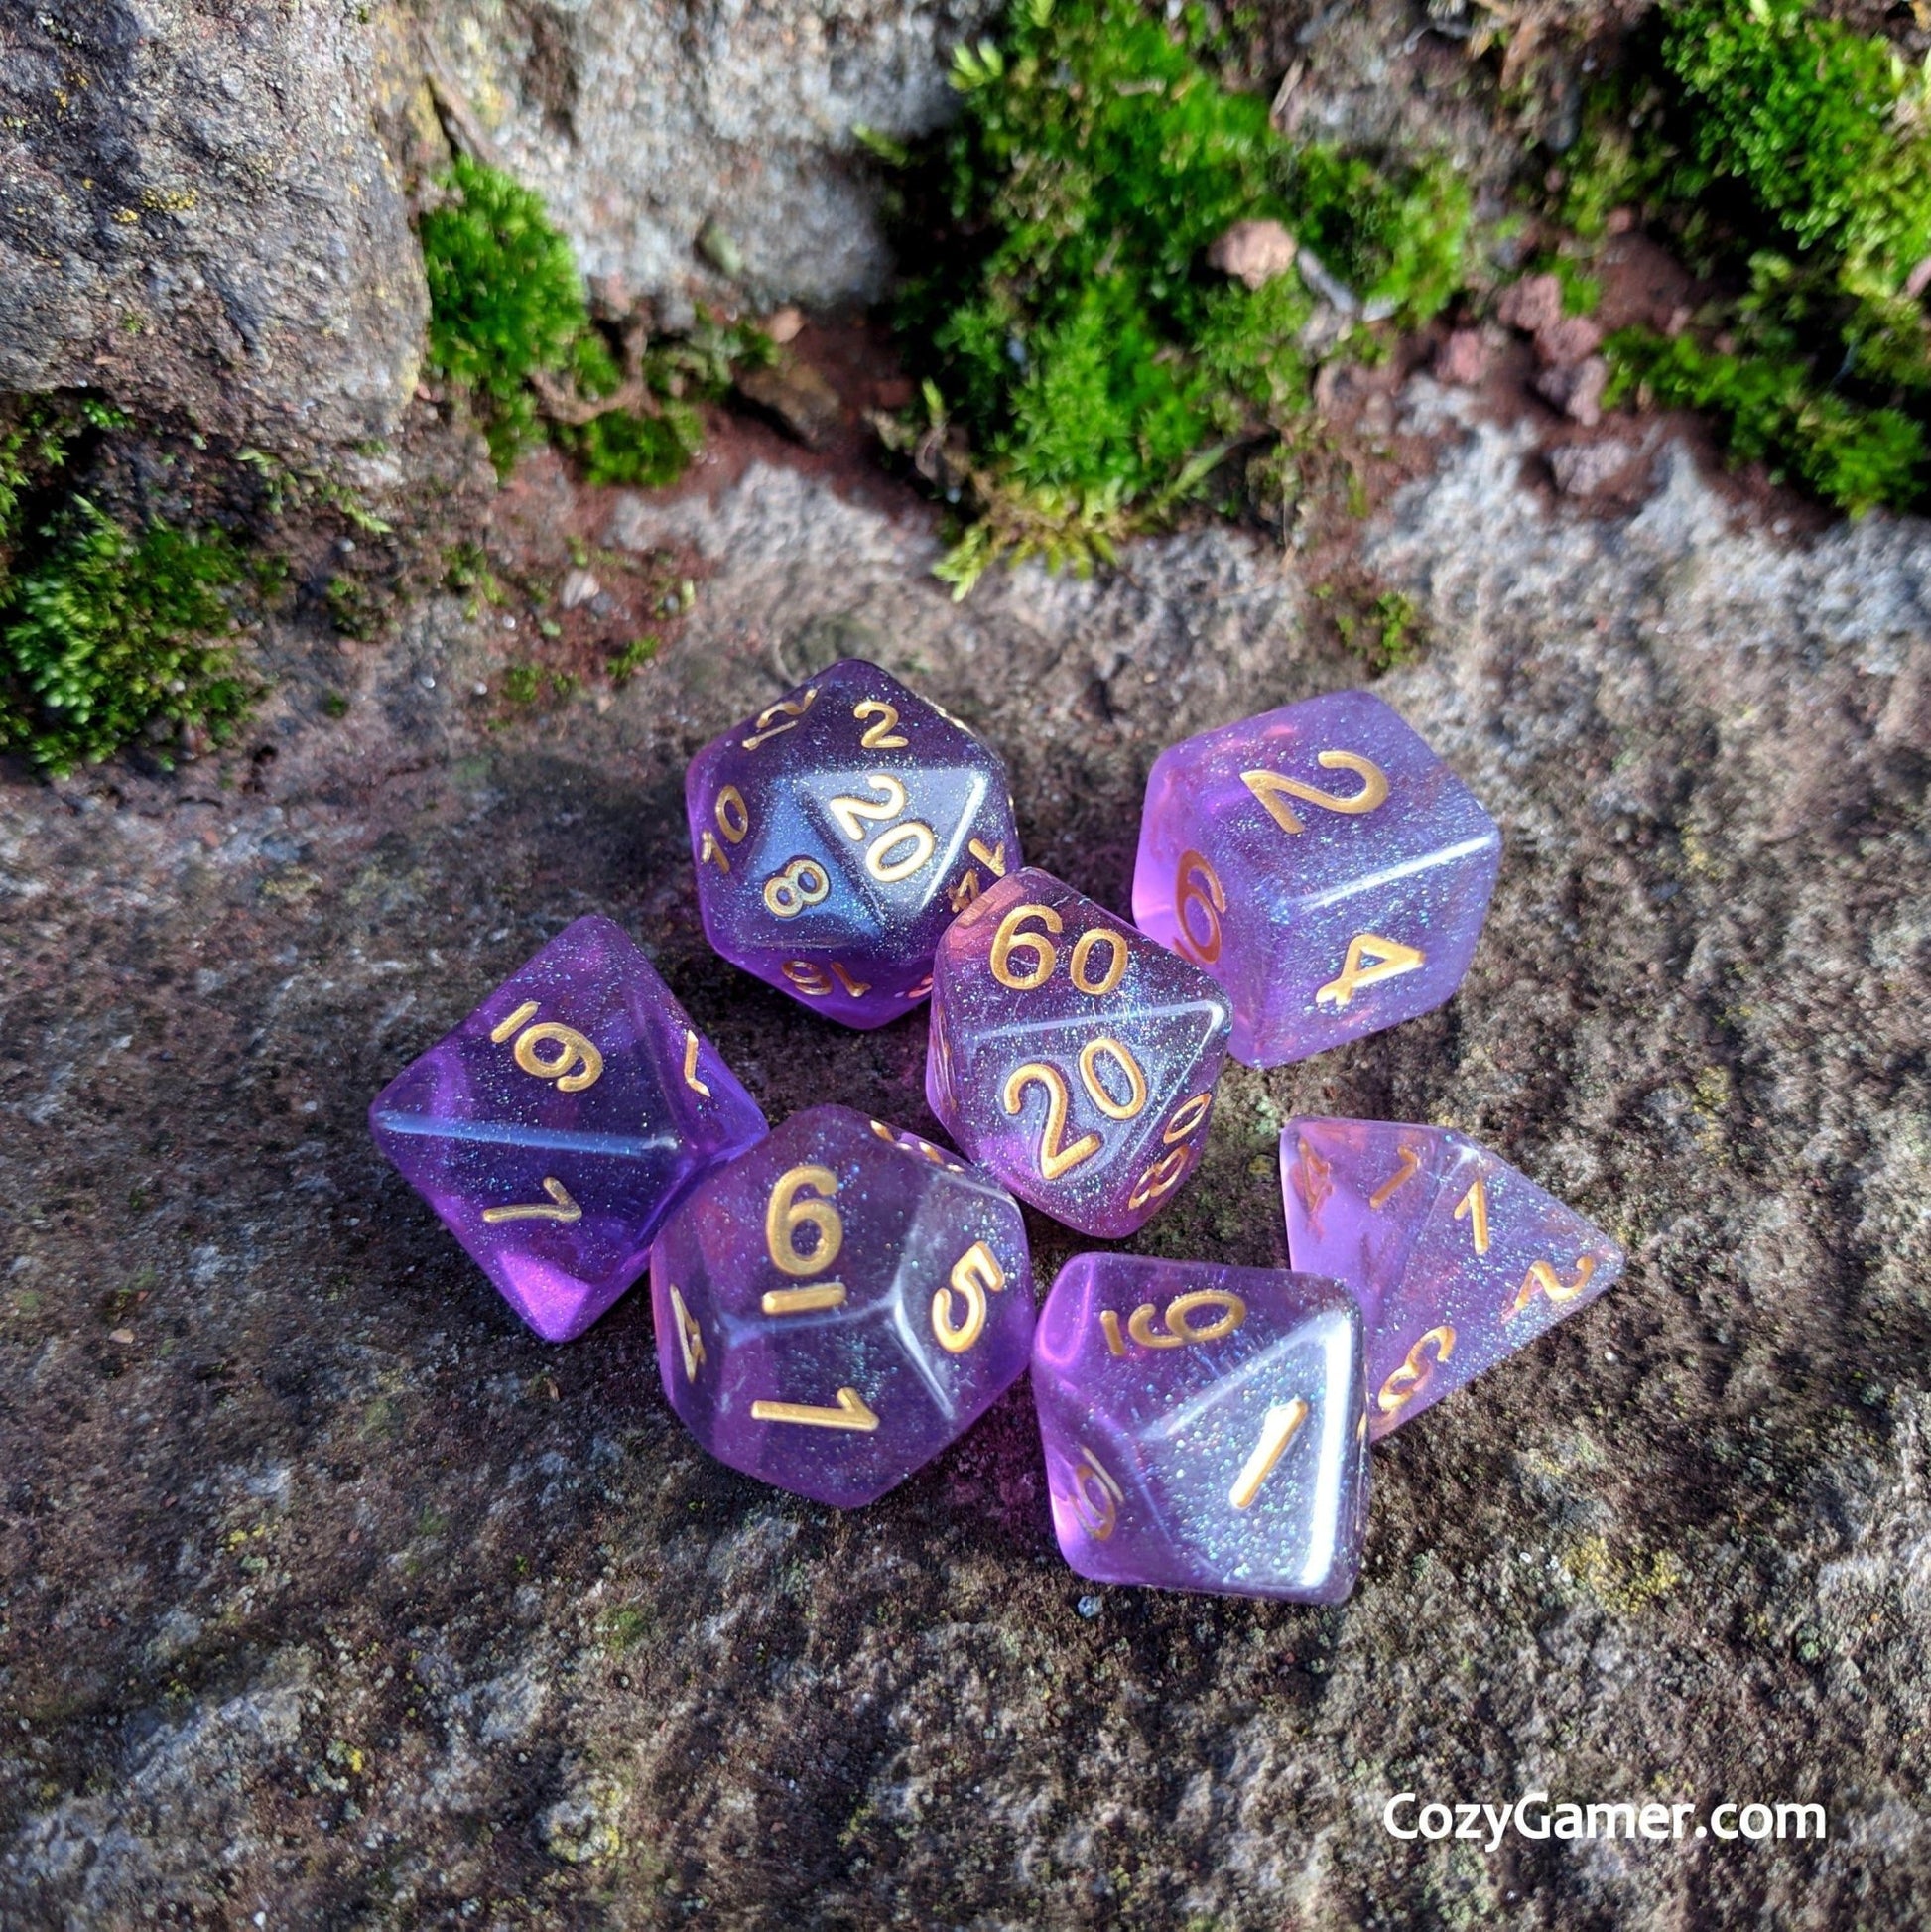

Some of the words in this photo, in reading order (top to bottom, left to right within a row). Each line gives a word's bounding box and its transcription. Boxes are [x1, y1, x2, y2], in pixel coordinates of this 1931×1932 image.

[852, 699, 910, 750] 2
[700, 784, 749, 875] 10
[829, 773, 936, 884] 20
[1238, 749, 1389, 835] 2
[763, 858, 831, 919] 8
[989, 903, 1128, 996] 60
[1314, 932, 1427, 1007] 4
[1002, 1037, 1148, 1181] 20
[1453, 1177, 1490, 1256] 1
[930, 1239, 1007, 1355] 5
[1514, 1255, 1596, 1312] 2
[751, 1386, 881, 1433] 1
[1377, 1324, 1458, 1413] 3
[1228, 1396, 1310, 1510] 1
